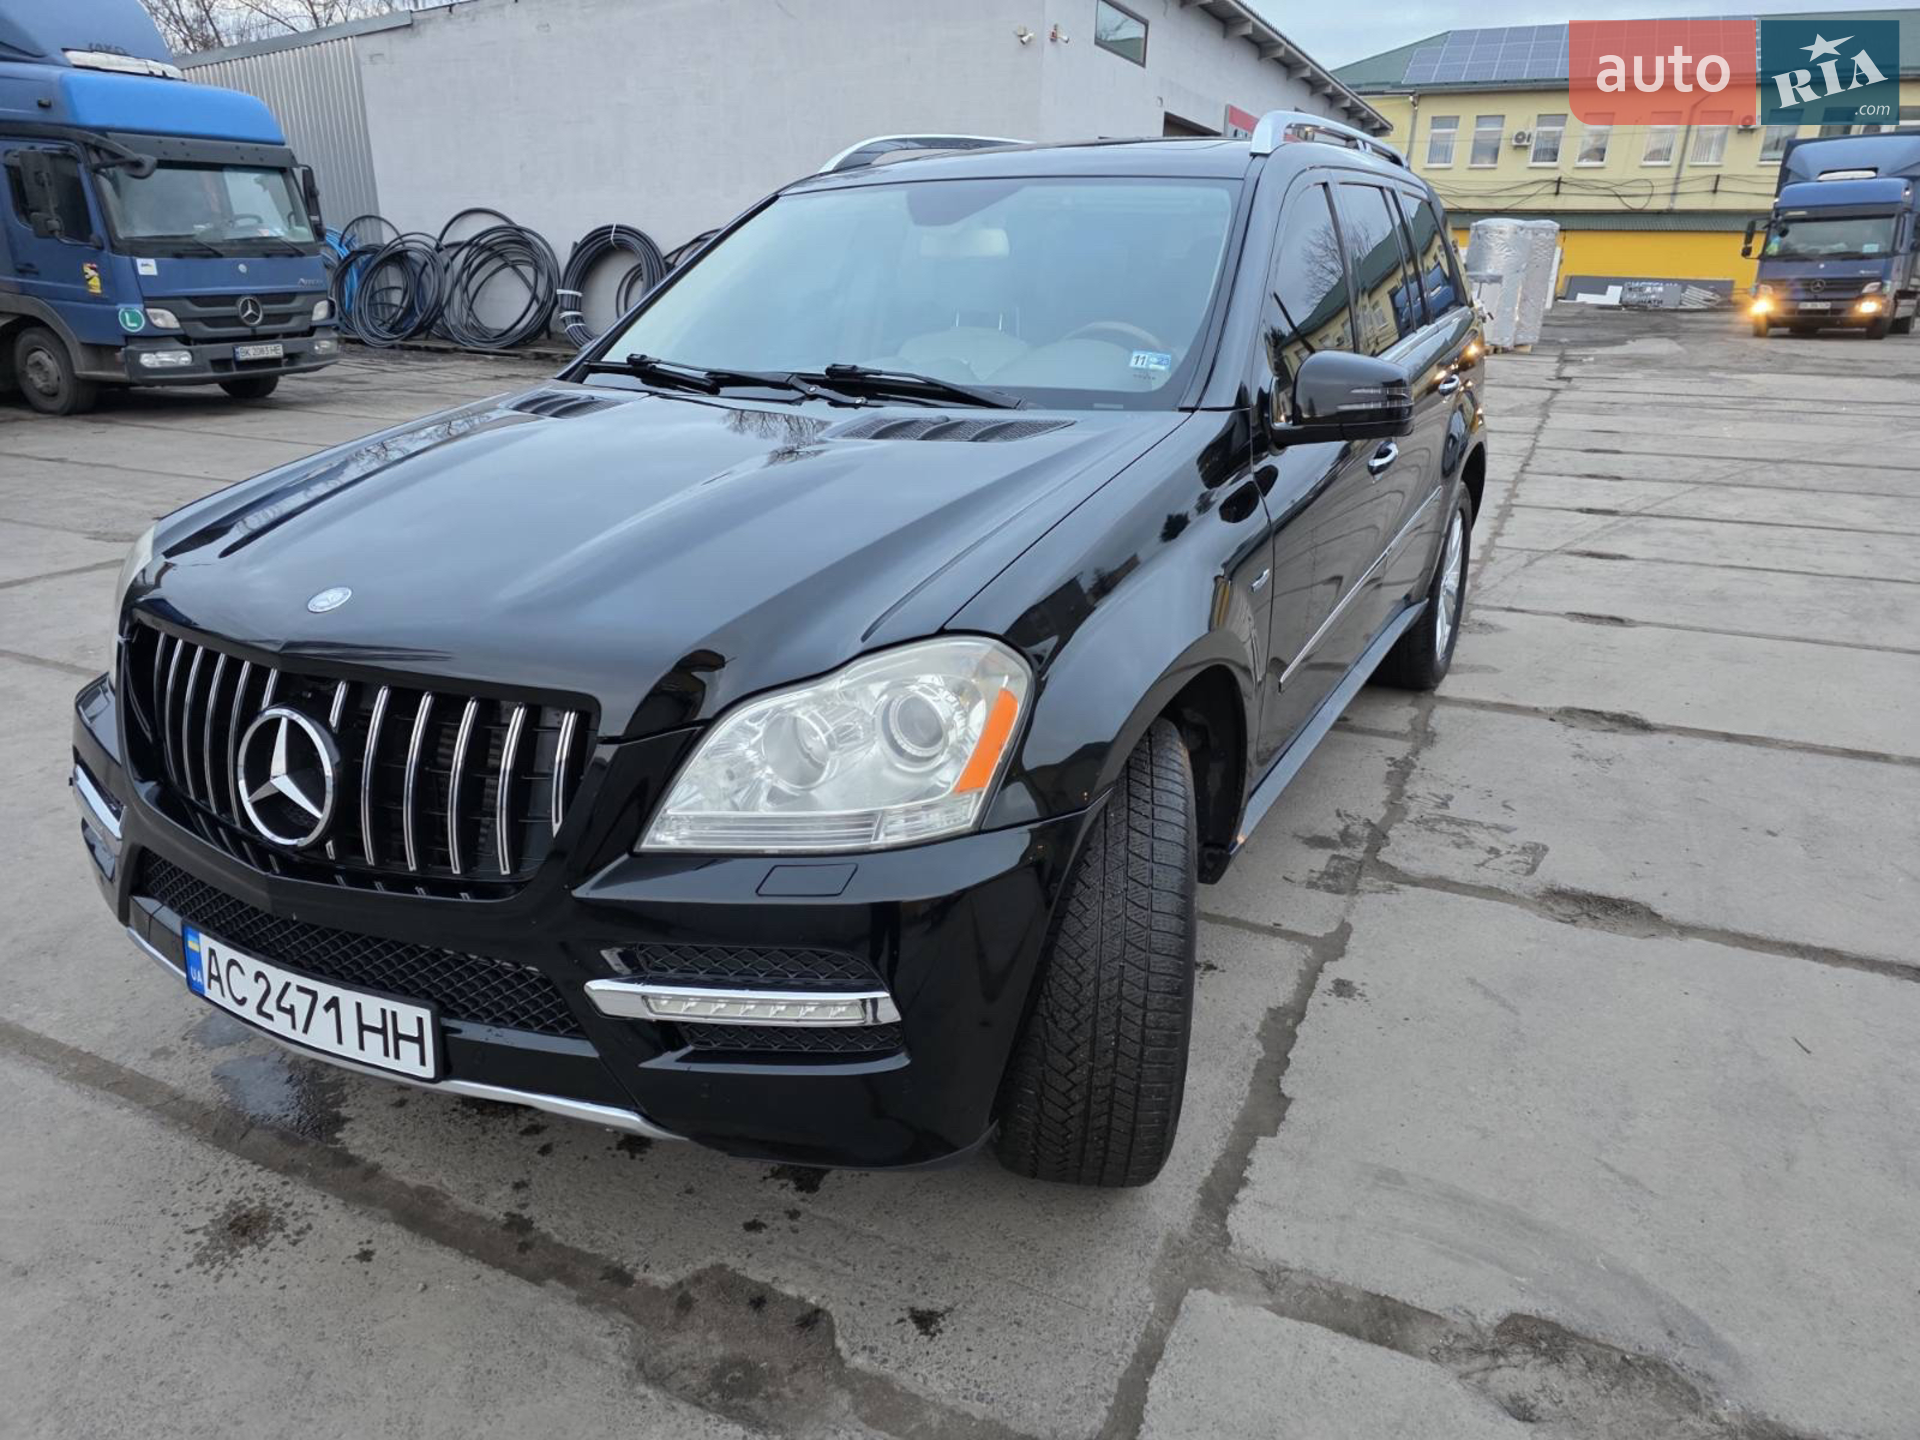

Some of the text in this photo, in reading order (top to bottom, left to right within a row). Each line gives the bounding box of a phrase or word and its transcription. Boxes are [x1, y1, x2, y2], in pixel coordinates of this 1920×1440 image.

[124, 312, 138, 327] L
[1133, 354, 1147, 366] 11
[190, 966, 204, 984] UA
[207, 947, 427, 1067] AC 2471 HH
